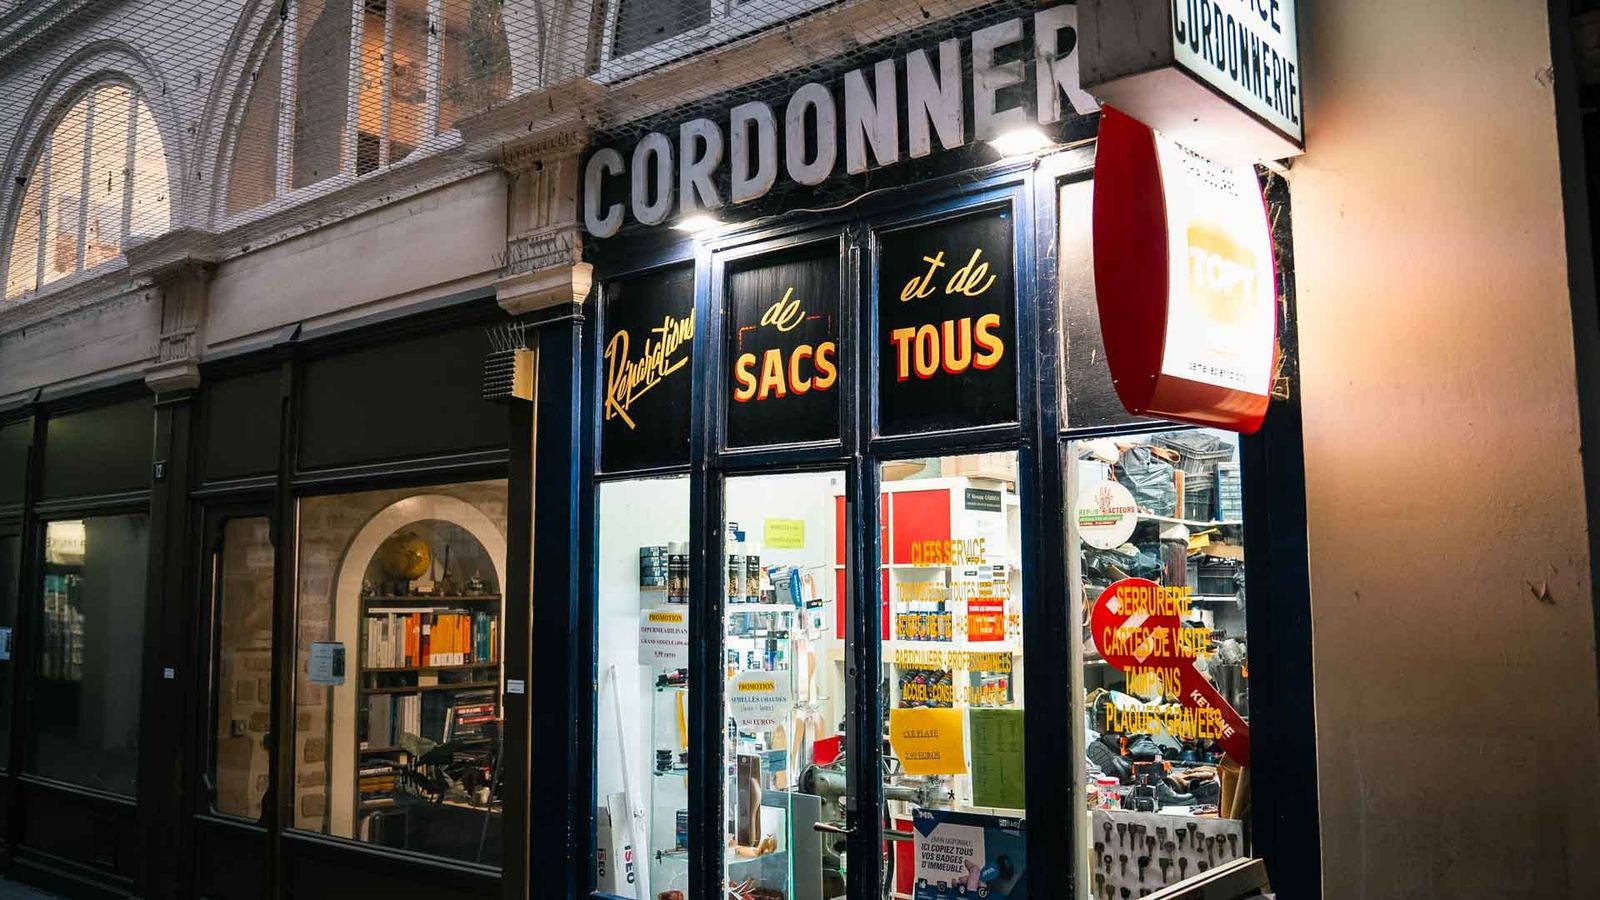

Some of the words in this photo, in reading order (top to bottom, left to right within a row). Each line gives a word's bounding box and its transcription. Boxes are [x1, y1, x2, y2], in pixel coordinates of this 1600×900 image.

[1173, 0, 1299, 126] CORDONNERIE
[900, 251, 946, 302] et
[945, 248, 997, 297] de
[760, 287, 806, 332] de
[890, 313, 1005, 383] TOUS
[734, 341, 838, 402] SACS
[911, 539, 942, 567] CLEFS
[943, 537, 987, 565] SERVICE
[649, 613, 683, 622] PROMOTION
[1116, 586, 1193, 617] SERRURERIE
[1103, 626, 1151, 658] CARTES
[1153, 626, 1171, 658] DE
[1172, 627, 1213, 660] VISITE
[738, 682, 775, 691] PROMOTION
[903, 683, 928, 701] ACCUEIL
[1124, 666, 1181, 698] TAMPONS
[1105, 703, 1161, 735] PLAQUES
[1164, 706, 1224, 740] GRAVEES
[624, 844, 636, 885] ISEO
[920, 843, 930, 851] ICI
[931, 844, 955, 855] COPIEZ
[955, 847, 974, 857] TOUS
[921, 852, 935, 861] VOS
[935, 853, 963, 864] BADGES
[921, 861, 964, 874] D'IMMEUBLE
